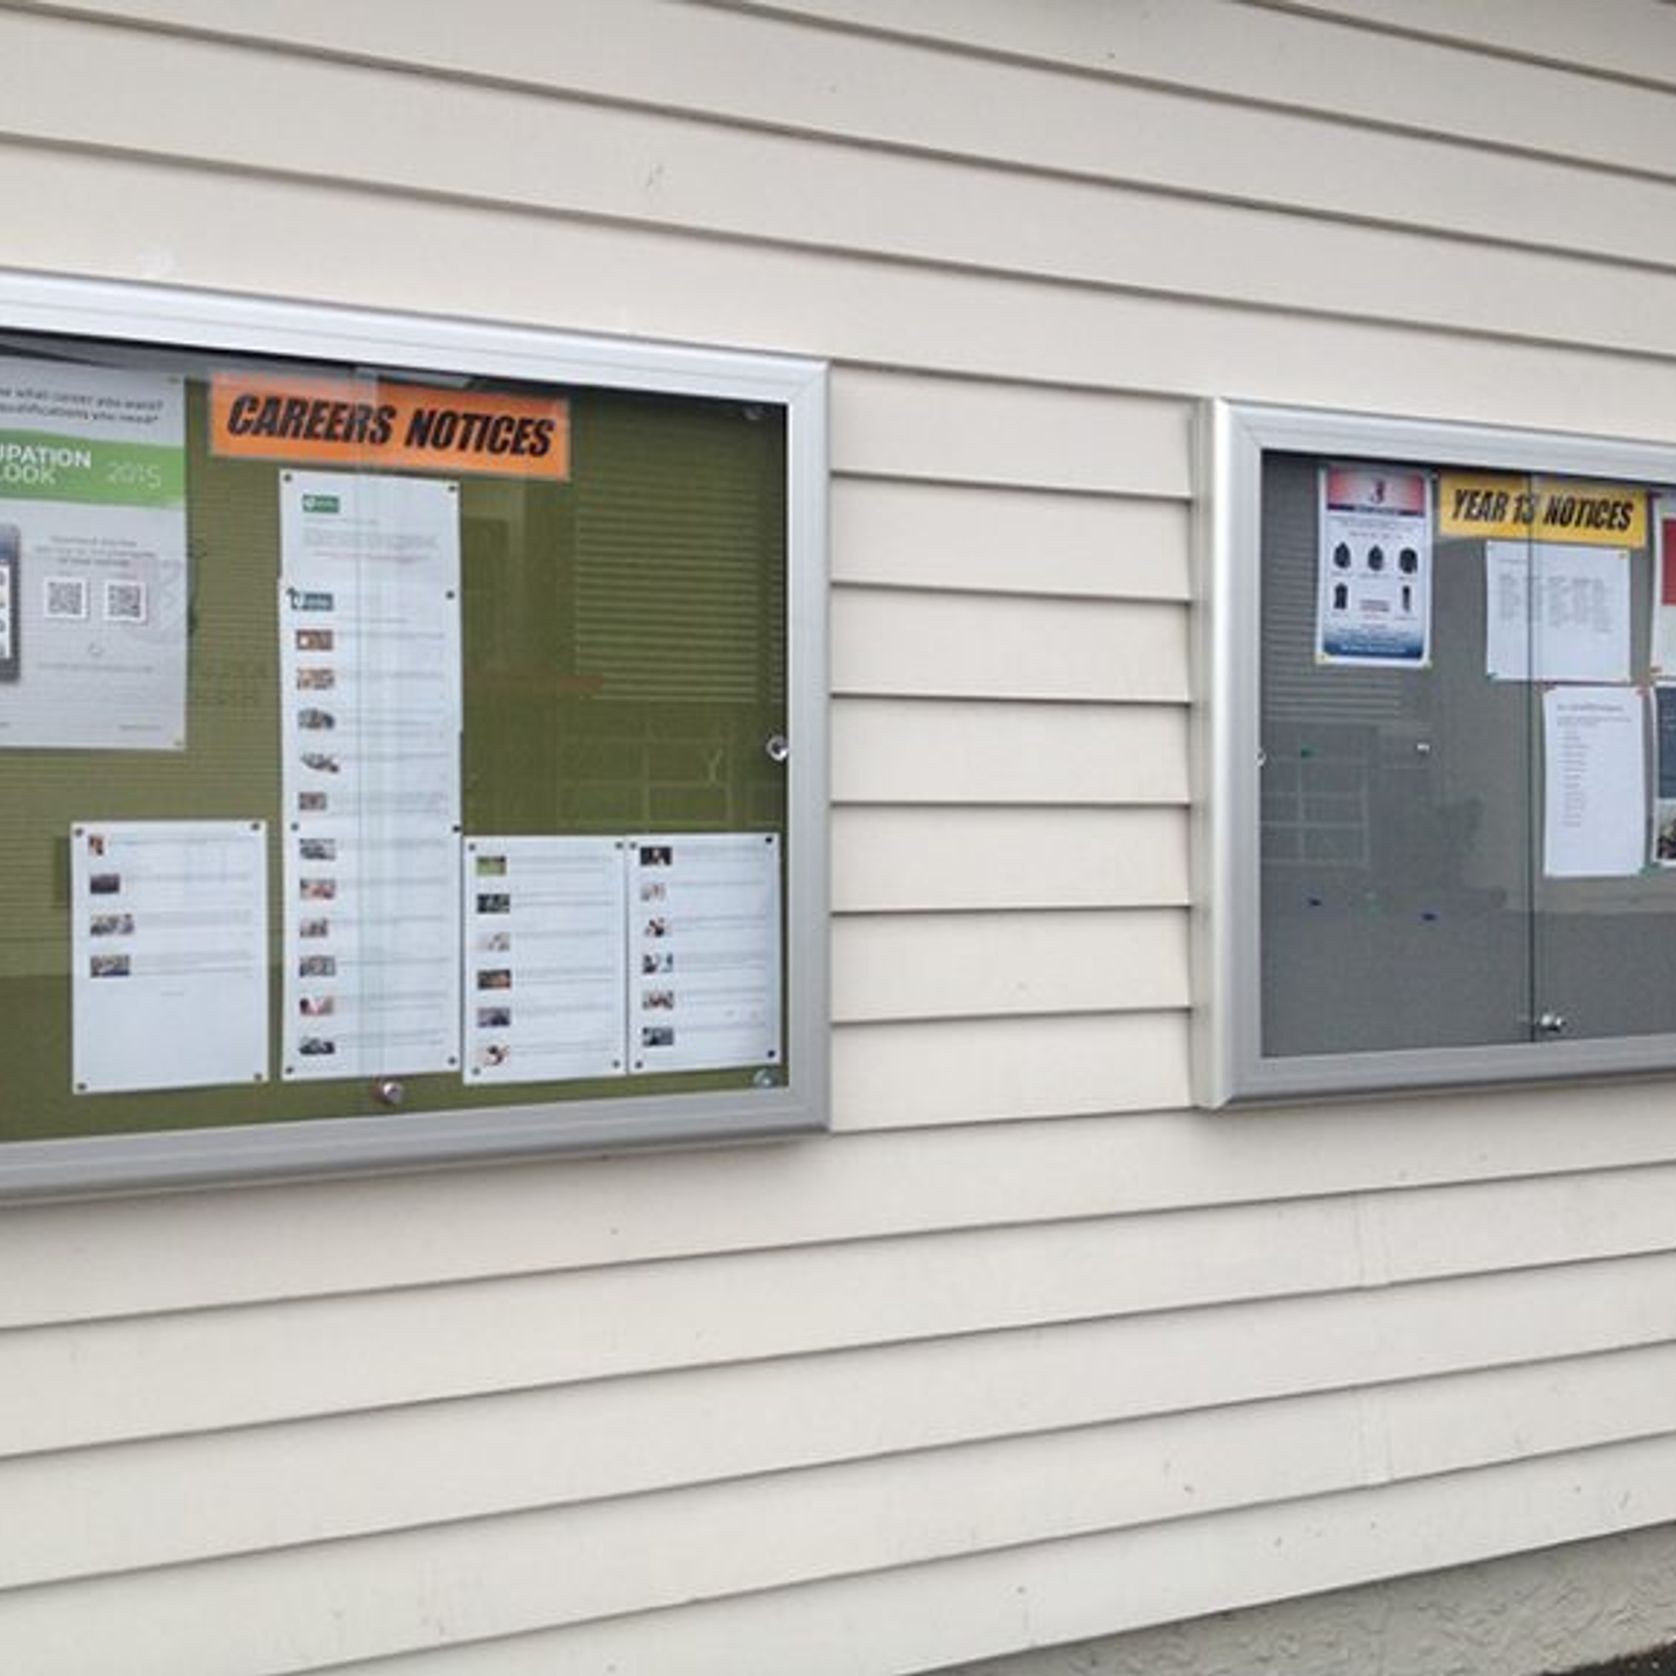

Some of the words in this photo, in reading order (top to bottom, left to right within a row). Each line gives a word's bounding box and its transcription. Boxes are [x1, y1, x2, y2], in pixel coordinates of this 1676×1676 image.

[227, 395, 397, 444] CAREERS
[404, 408, 554, 458] NOTICES
[0, 443, 91, 469] PATION
[107, 461, 161, 489] 2015
[1452, 488, 1509, 522] YEAR
[1543, 495, 1634, 532] NOTICES
